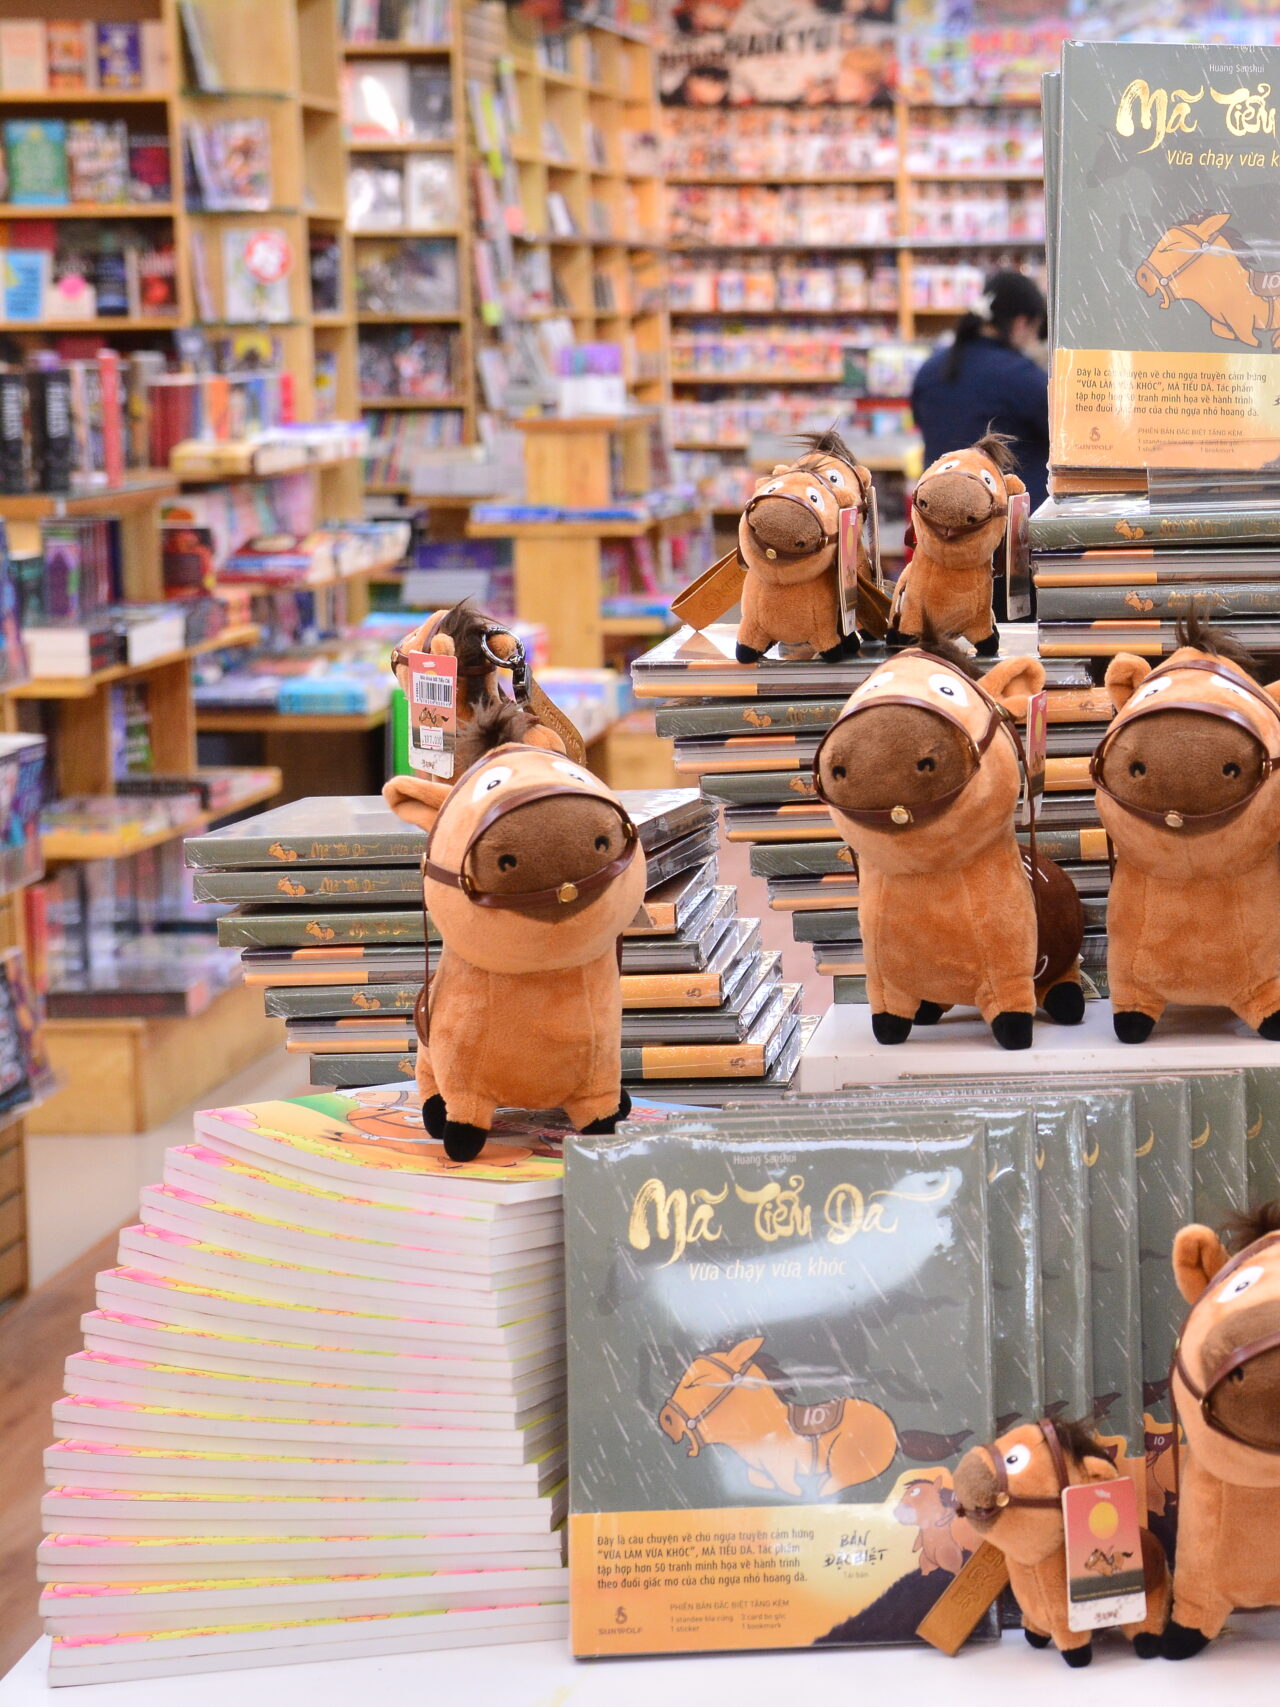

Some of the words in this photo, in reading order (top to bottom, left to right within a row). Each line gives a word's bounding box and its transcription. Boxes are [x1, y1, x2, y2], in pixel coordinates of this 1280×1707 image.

[1209, 63, 1233, 76] Huang
[1116, 78, 1204, 154] Mã
[1210, 82, 1277, 139] Tiểu
[1167, 150, 1193, 166] Vừa
[1200, 150, 1233, 170] chạy
[1239, 150, 1265, 167] vừa
[733, 1153, 762, 1167] Huang
[628, 1178, 729, 1270] Mã
[735, 1174, 813, 1242] Tiểu
[824, 1175, 952, 1244] Dã
[689, 1261, 720, 1281] Vừa
[726, 1259, 766, 1284] chạy
[771, 1258, 801, 1280] vừa
[807, 1255, 847, 1277] khóc
[803, 1406, 827, 1426] 10
[598, 1535, 614, 1546] Đây
[618, 1535, 625, 1545] là
[629, 1535, 644, 1545] câu
[647, 1533, 678, 1546] chuyện
[682, 1532, 693, 1543] về
[695, 1531, 710, 1542] chú
[714, 1532, 736, 1544] ngựa
[739, 1530, 768, 1542] truyền
[771, 1529, 789, 1540] cảm
[792, 1528, 814, 1541] hứng
[840, 1529, 871, 1547] BẢN
[624, 1547, 642, 1559] LÀM
[646, 1546, 663, 1558] VỪA
[702, 1545, 716, 1556] MÃ
[719, 1544, 737, 1556] TIỂU
[758, 1544, 772, 1555] Tác
